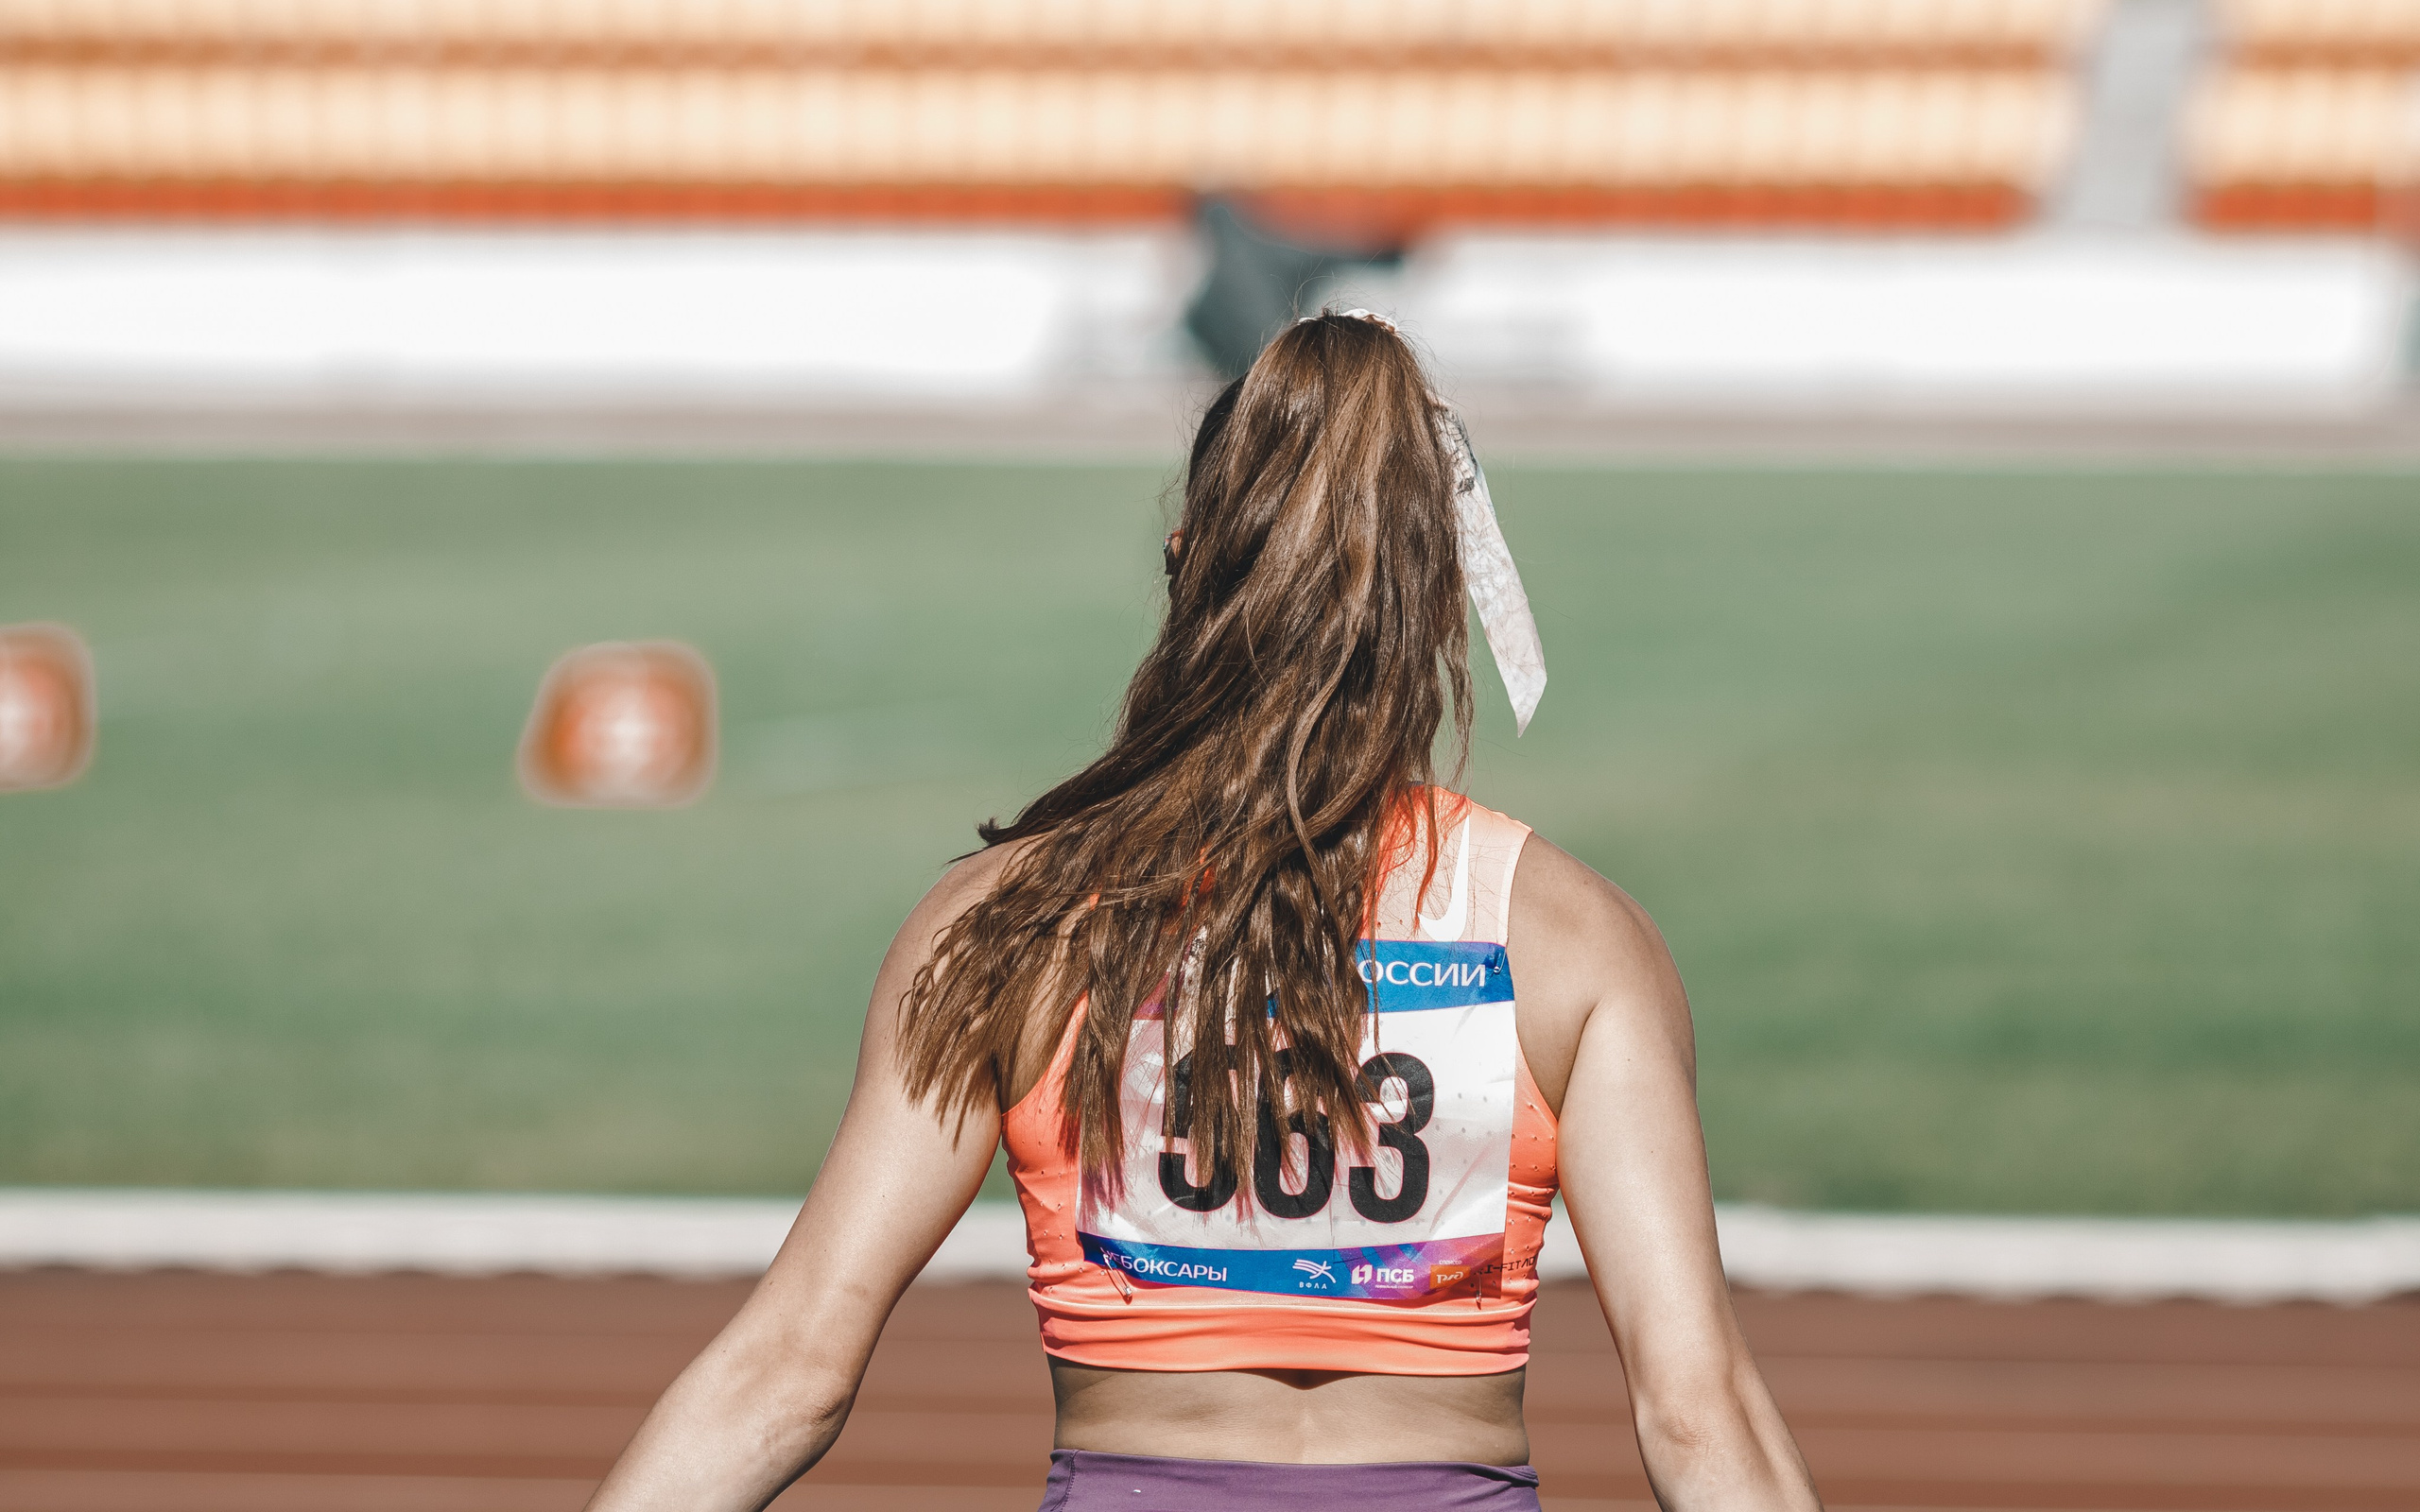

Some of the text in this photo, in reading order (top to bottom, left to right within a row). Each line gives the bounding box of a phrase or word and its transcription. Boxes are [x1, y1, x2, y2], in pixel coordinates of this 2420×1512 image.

[1357, 959, 1486, 988] ОССИИ
[1158, 1044, 1435, 1224] 563
[1376, 1268, 1415, 1283] ПСБ
